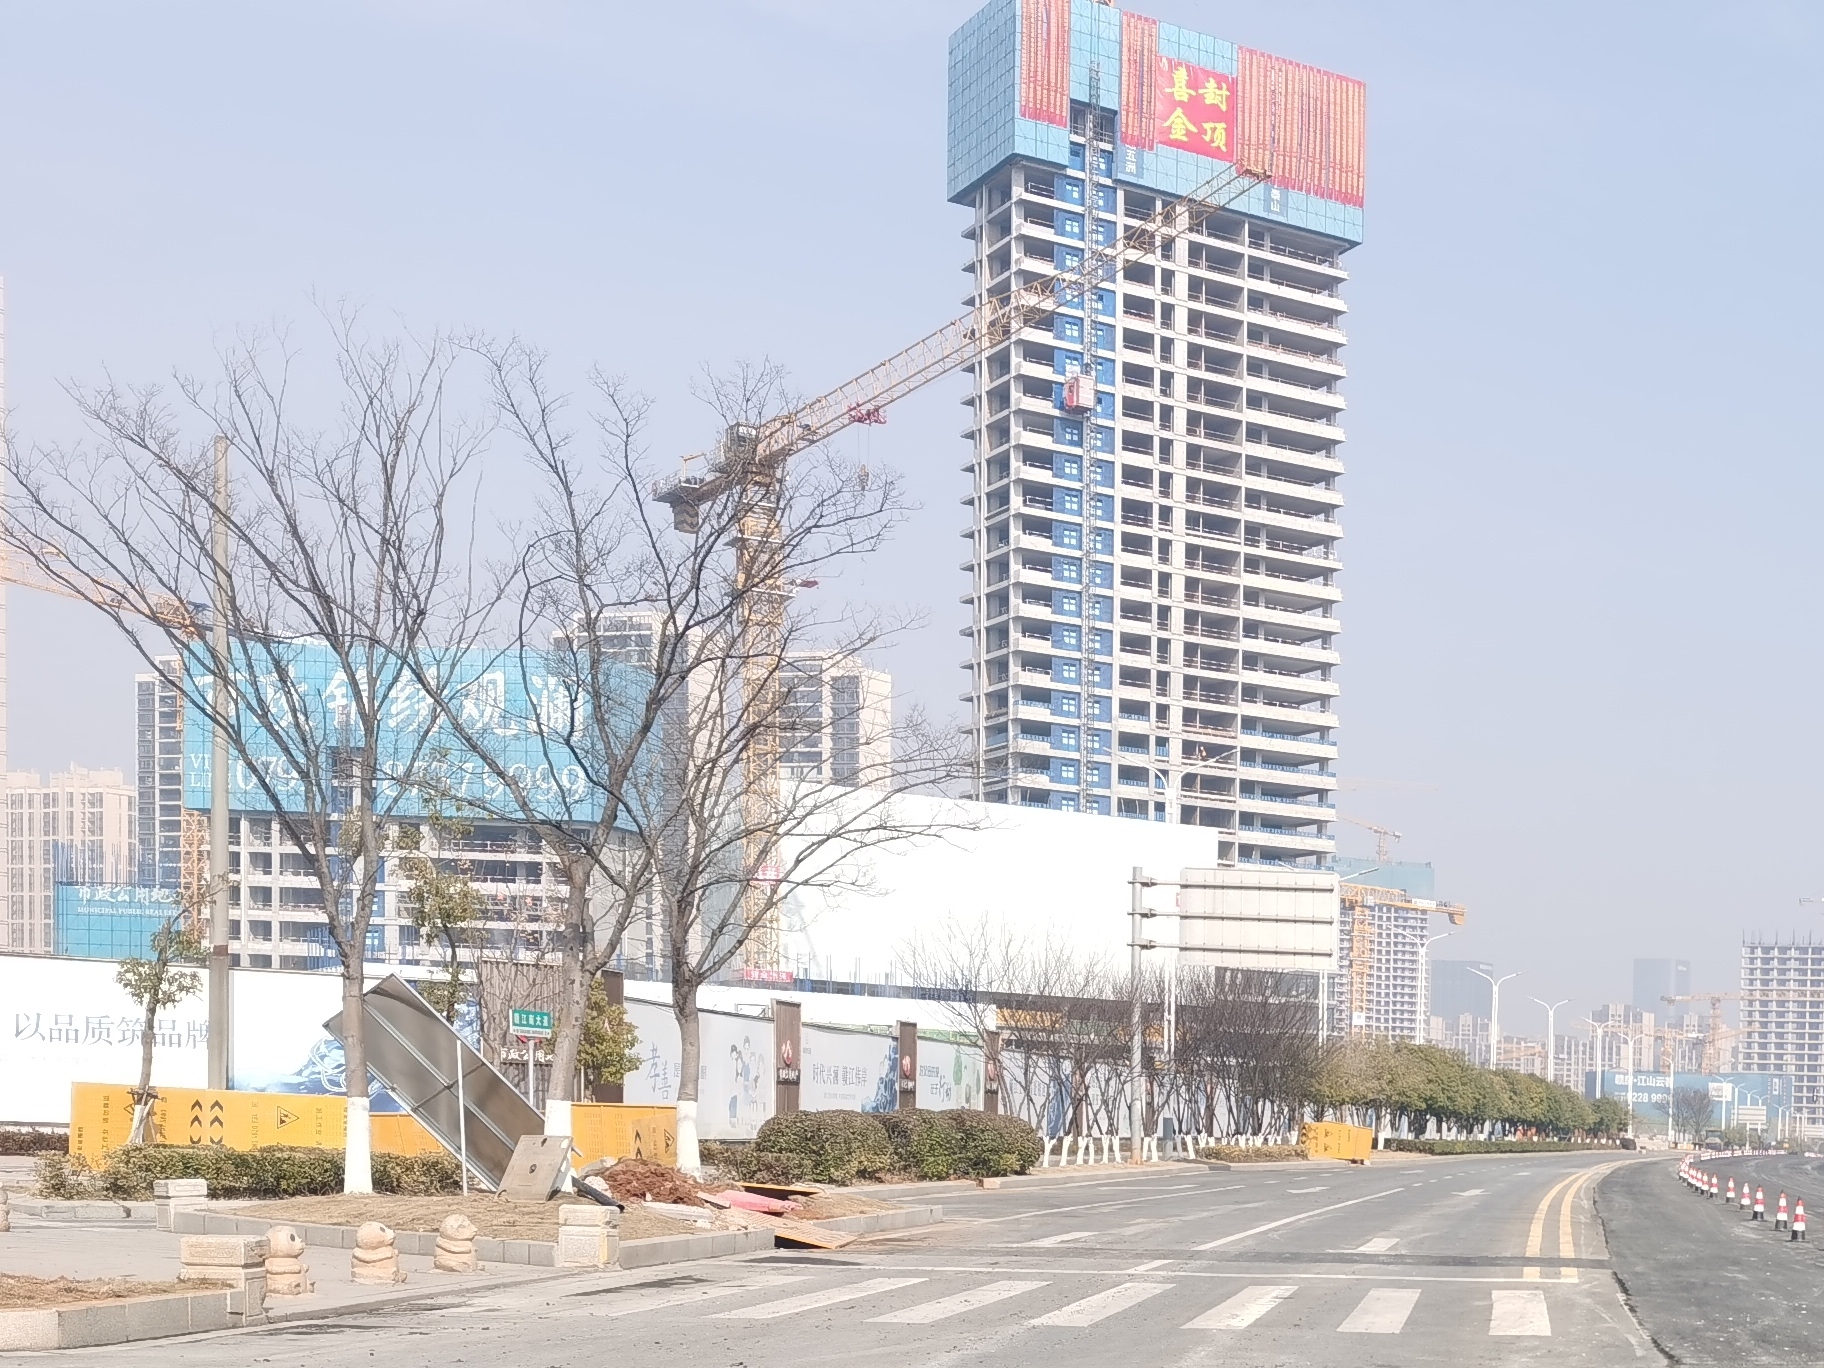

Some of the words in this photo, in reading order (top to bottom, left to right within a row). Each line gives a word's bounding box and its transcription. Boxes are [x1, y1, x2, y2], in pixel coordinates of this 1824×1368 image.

[1164, 66, 1231, 112] 喜封
[1161, 106, 1228, 153] 金顶
[77, 906, 117, 915] MUNICIPAL
[119, 907, 143, 915] PUBLIC
[15, 1012, 209, 1050] 以品质筑品牌
